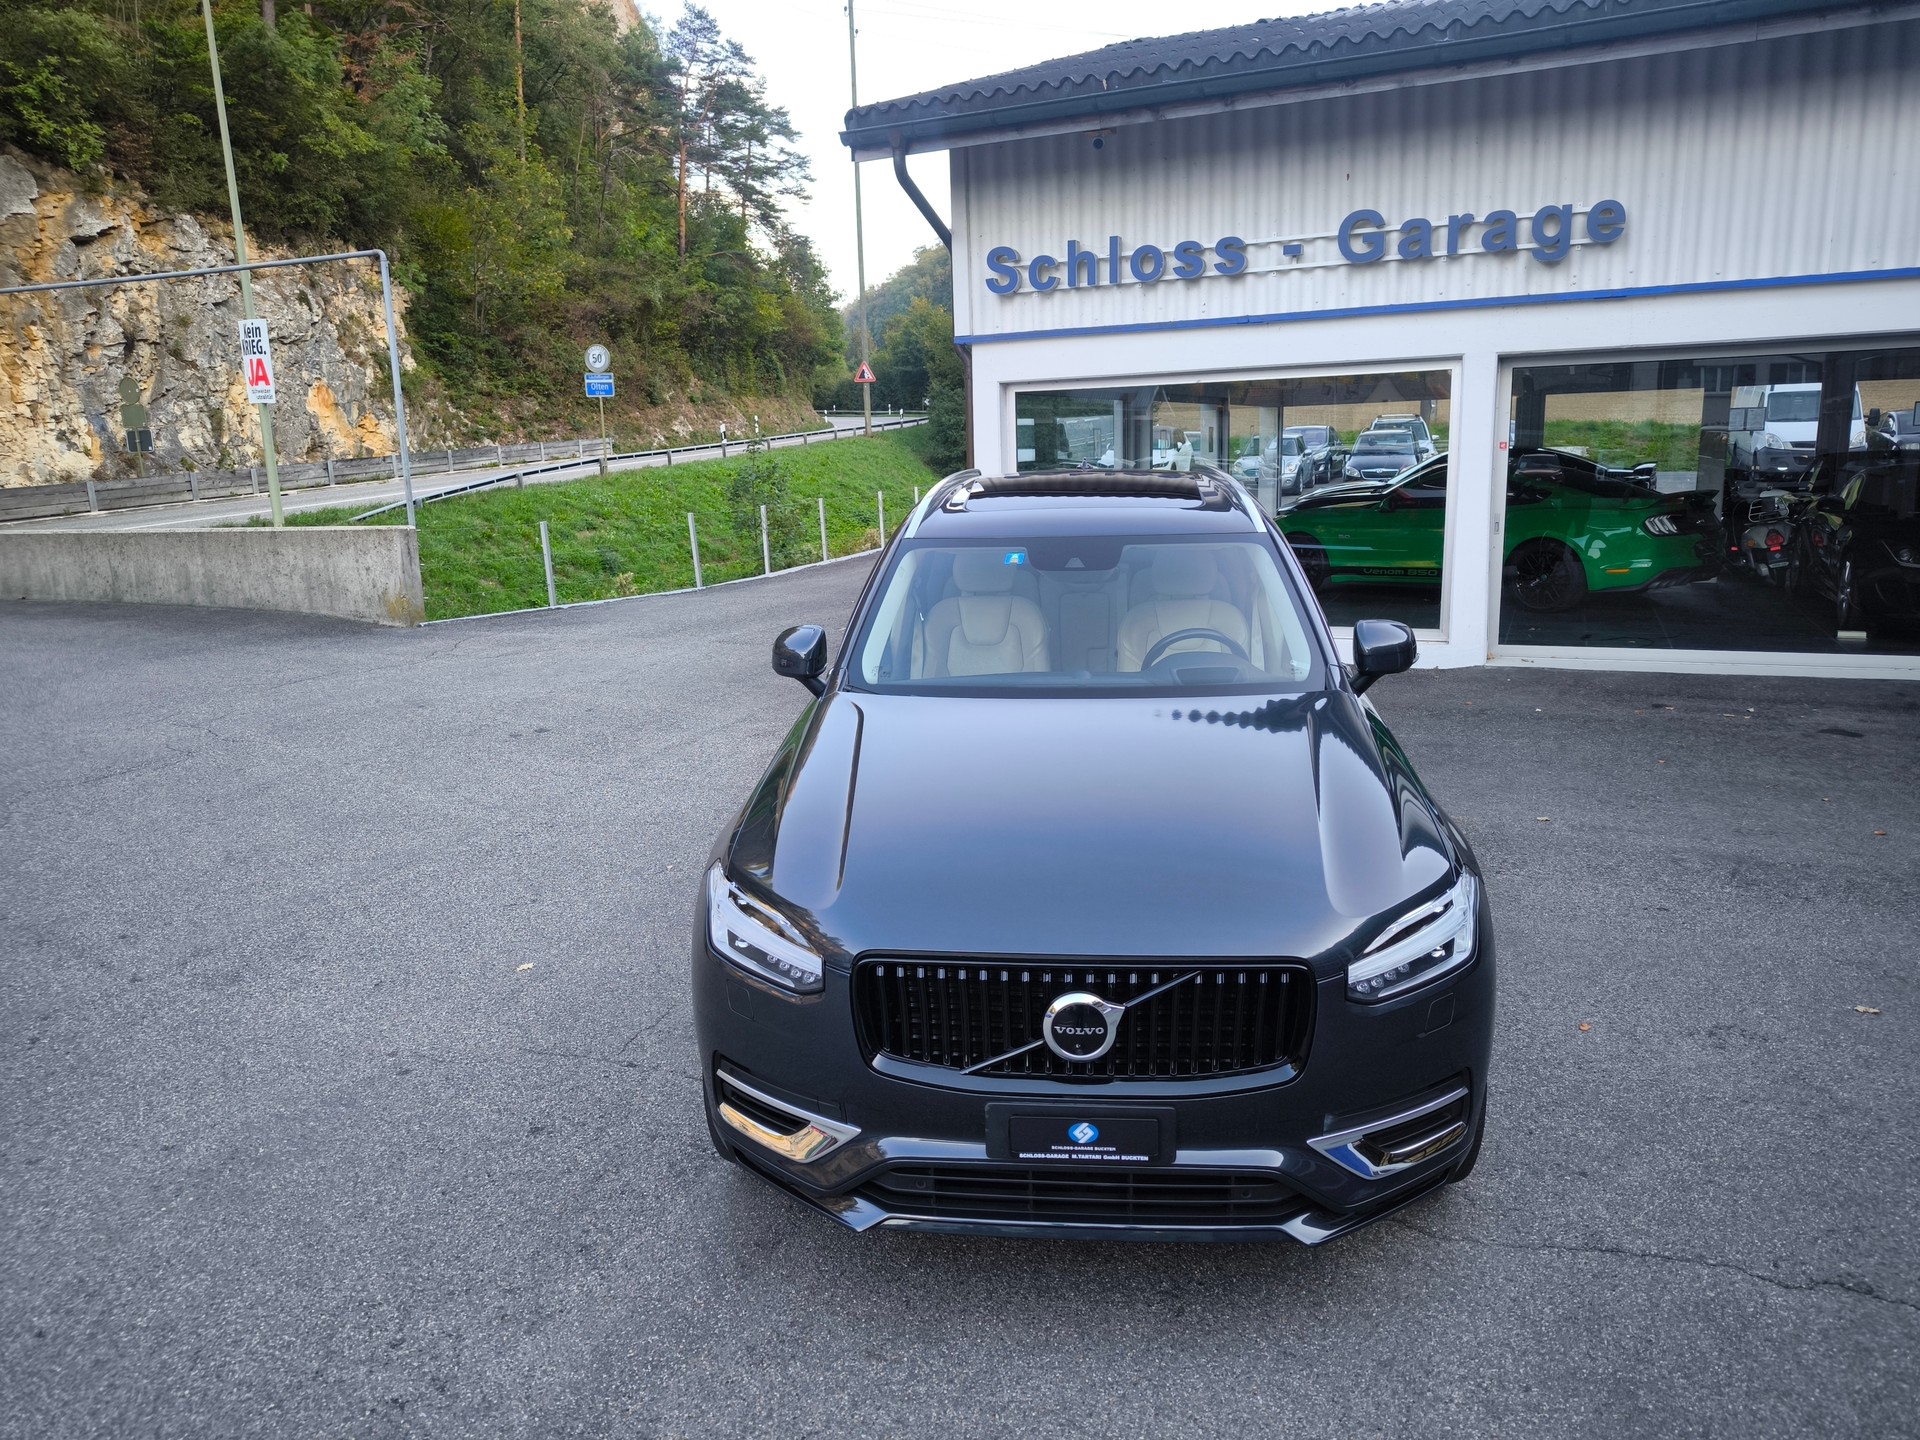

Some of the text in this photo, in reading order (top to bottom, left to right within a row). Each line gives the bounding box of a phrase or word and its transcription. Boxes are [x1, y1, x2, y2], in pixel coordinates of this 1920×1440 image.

[985, 235, 1248, 295] Schloss
[1337, 199, 1626, 264] Garage
[592, 353, 603, 364] 50
[248, 358, 271, 387] JA
[590, 382, 609, 391] Olten
[1054, 1026, 1105, 1035] VOLVO
